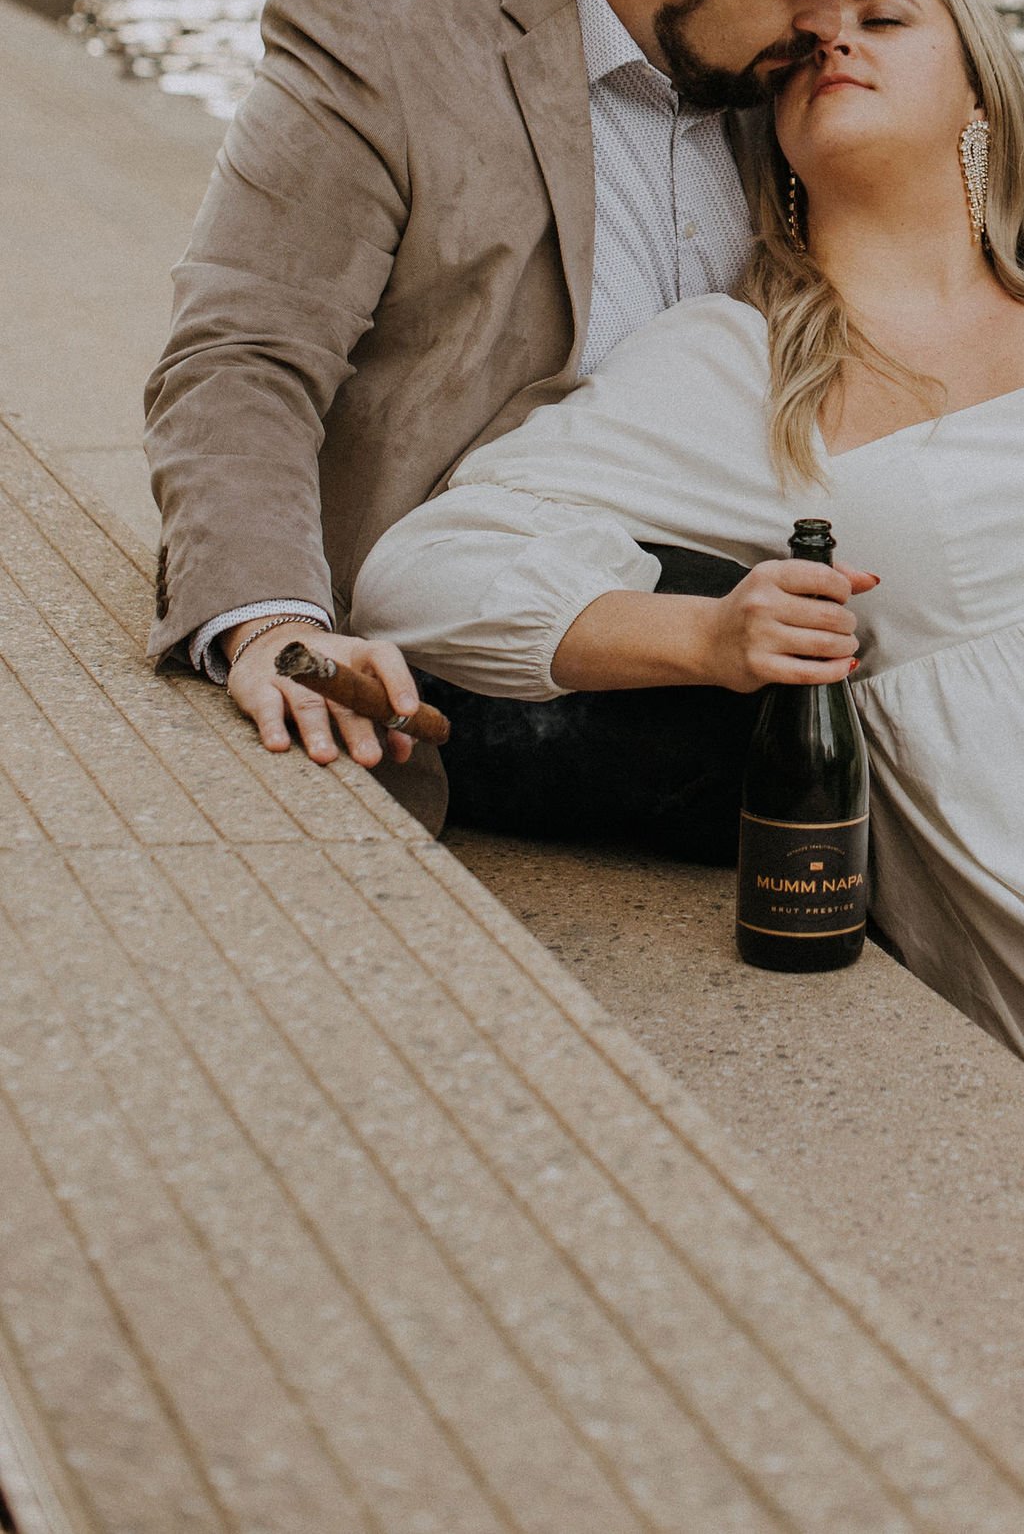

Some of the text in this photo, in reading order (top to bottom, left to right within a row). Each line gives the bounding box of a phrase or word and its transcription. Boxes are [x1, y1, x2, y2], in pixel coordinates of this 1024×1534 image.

[757, 873, 863, 893] MUMM NAPA
[805, 903, 855, 914] PRESTIGE
